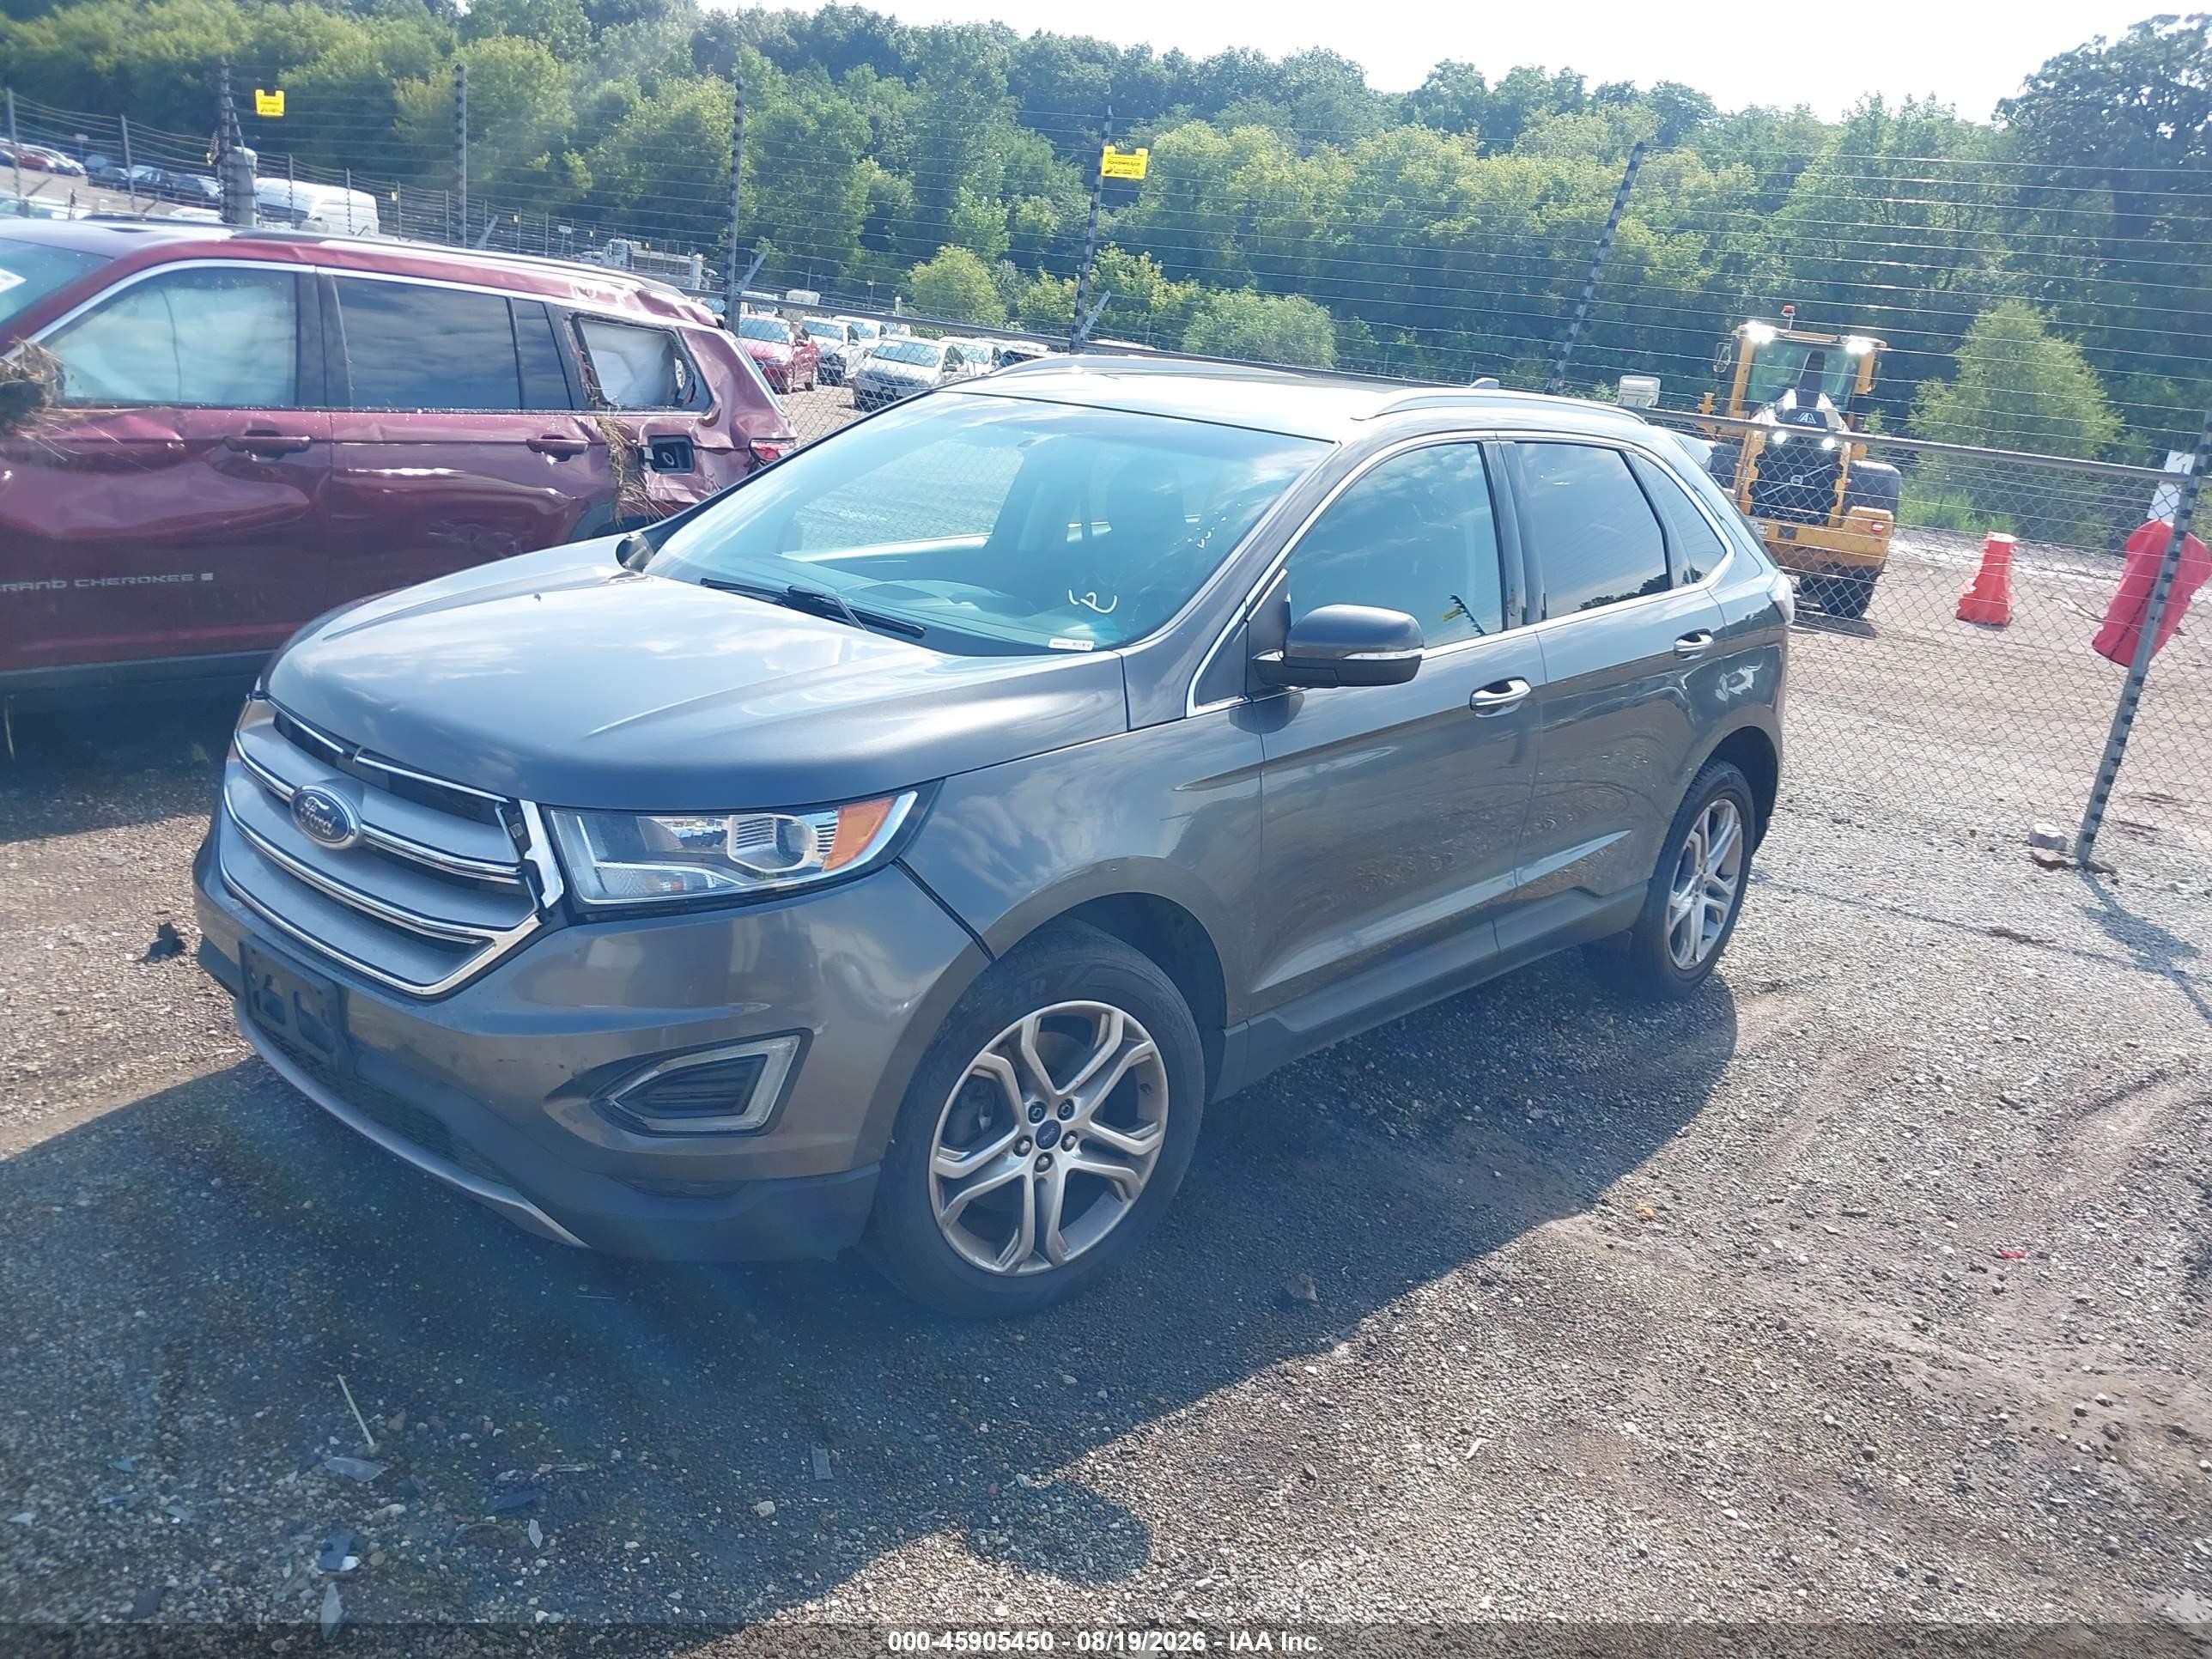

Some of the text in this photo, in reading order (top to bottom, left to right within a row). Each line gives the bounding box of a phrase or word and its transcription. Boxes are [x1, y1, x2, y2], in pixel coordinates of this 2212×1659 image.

[0, 579, 68, 592] RAND
[74, 573, 195, 588] CHEROKEE
[300, 796, 337, 836] Ford
